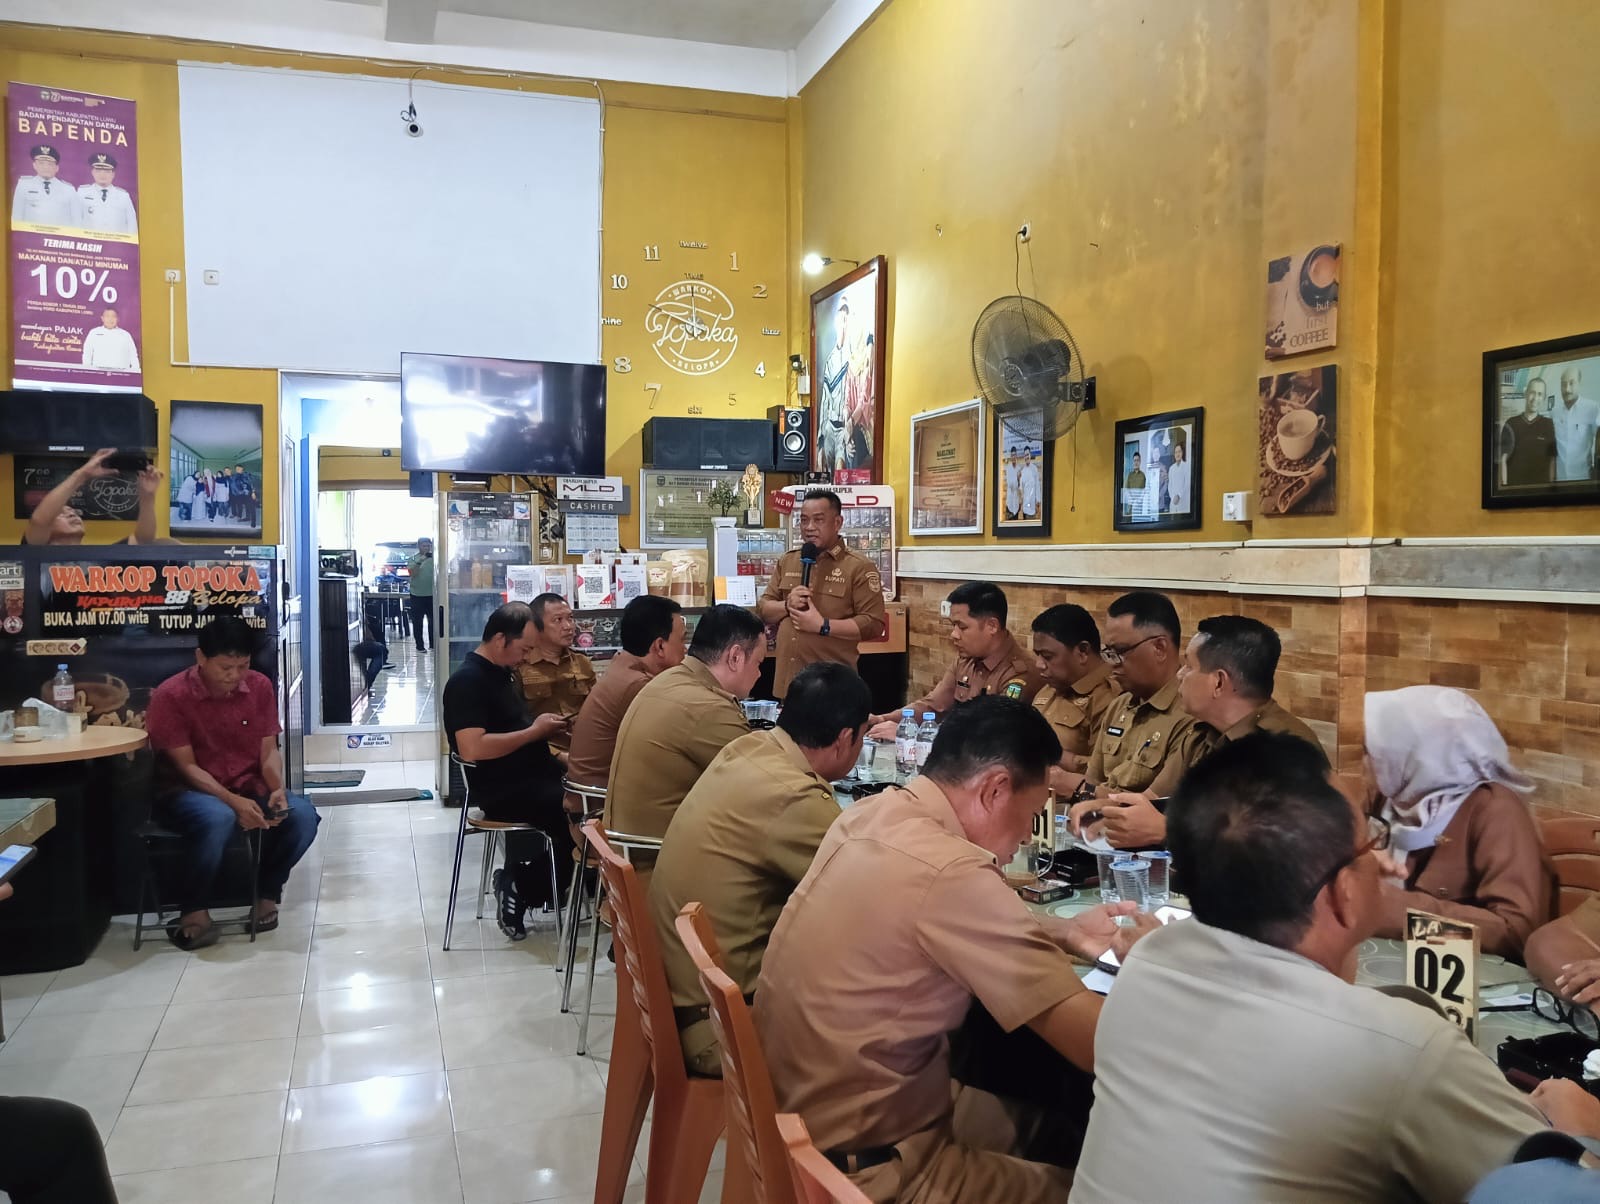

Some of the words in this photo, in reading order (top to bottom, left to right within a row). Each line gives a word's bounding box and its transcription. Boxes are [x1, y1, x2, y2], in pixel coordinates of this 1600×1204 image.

[18, 110, 45, 120] BADAN
[46, 114, 94, 127] PENDAPATAN
[95, 121, 125, 131] DAERAH
[18, 117, 128, 147] BAPENDA
[43, 238, 75, 250] TERIMA
[76, 242, 103, 253] KASIH
[644, 246, 660, 260] 11
[18, 253, 57, 263] MAKANAN
[95, 261, 129, 271] MINUMAN
[729, 252, 740, 271] 1
[30, 264, 118, 303] 10%
[611, 274, 627, 289] 10
[672, 285, 713, 296] WARKOP
[753, 284, 768, 299] 2
[601, 317, 622, 326] nine
[54, 325, 84, 335] PAJAK
[645, 312, 738, 355] Topoka
[1289, 328, 1329, 347] COFFEE
[614, 357, 632, 373] 8
[677, 361, 715, 371] BELOPA
[755, 361, 766, 377] 4
[644, 383, 662, 409] 7
[728, 394, 737, 406] 5
[687, 405, 702, 414] six
[563, 484, 615, 492] MLD
[570, 502, 614, 512] CASHIER
[775, 497, 793, 508] NEW
[49, 565, 156, 593] WARKOP
[162, 565, 261, 592] TOPOKA
[825, 576, 845, 584] BUPATI
[165, 590, 191, 605] 88
[192, 590, 262, 608] Belopa
[44, 612, 73, 627] BUKA
[75, 611, 97, 626] JAM
[98, 611, 126, 626] 07.00
[128, 611, 149, 625] wita
[159, 615, 192, 629] TUTUP
[1032, 808, 1048, 840] 01
[1414, 946, 1466, 1005] 02
